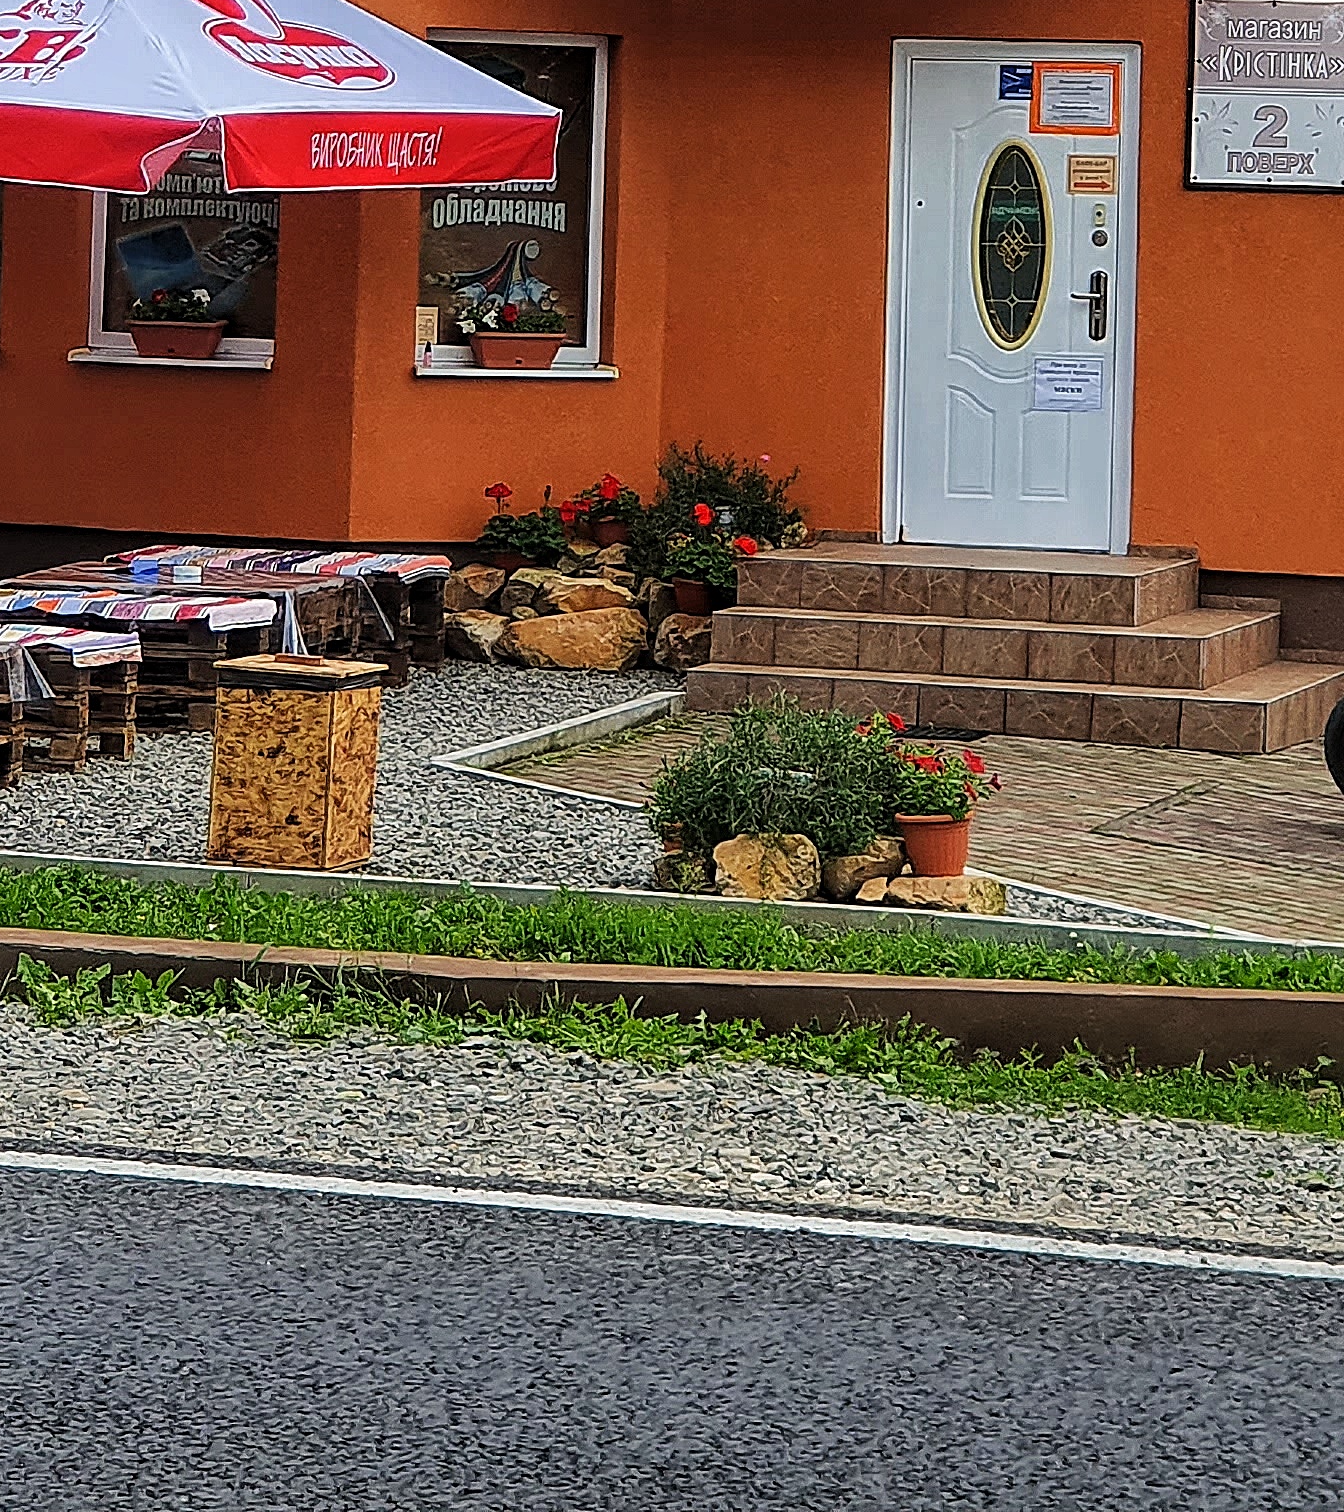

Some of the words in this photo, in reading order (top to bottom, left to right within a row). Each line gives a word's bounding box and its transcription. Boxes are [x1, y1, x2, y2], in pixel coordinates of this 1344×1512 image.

[1227, 18, 1323, 40] магазин
[1252, 104, 1289, 148] 2
[310, 131, 383, 170] ВИРОБНИК
[386, 126, 444, 176] ЩАСТЯ!
[1226, 151, 1315, 175] ПОВЕРХ
[120, 197, 139, 223] та
[142, 197, 280, 229] комплектуючі
[432, 193, 567, 233] обладнання
